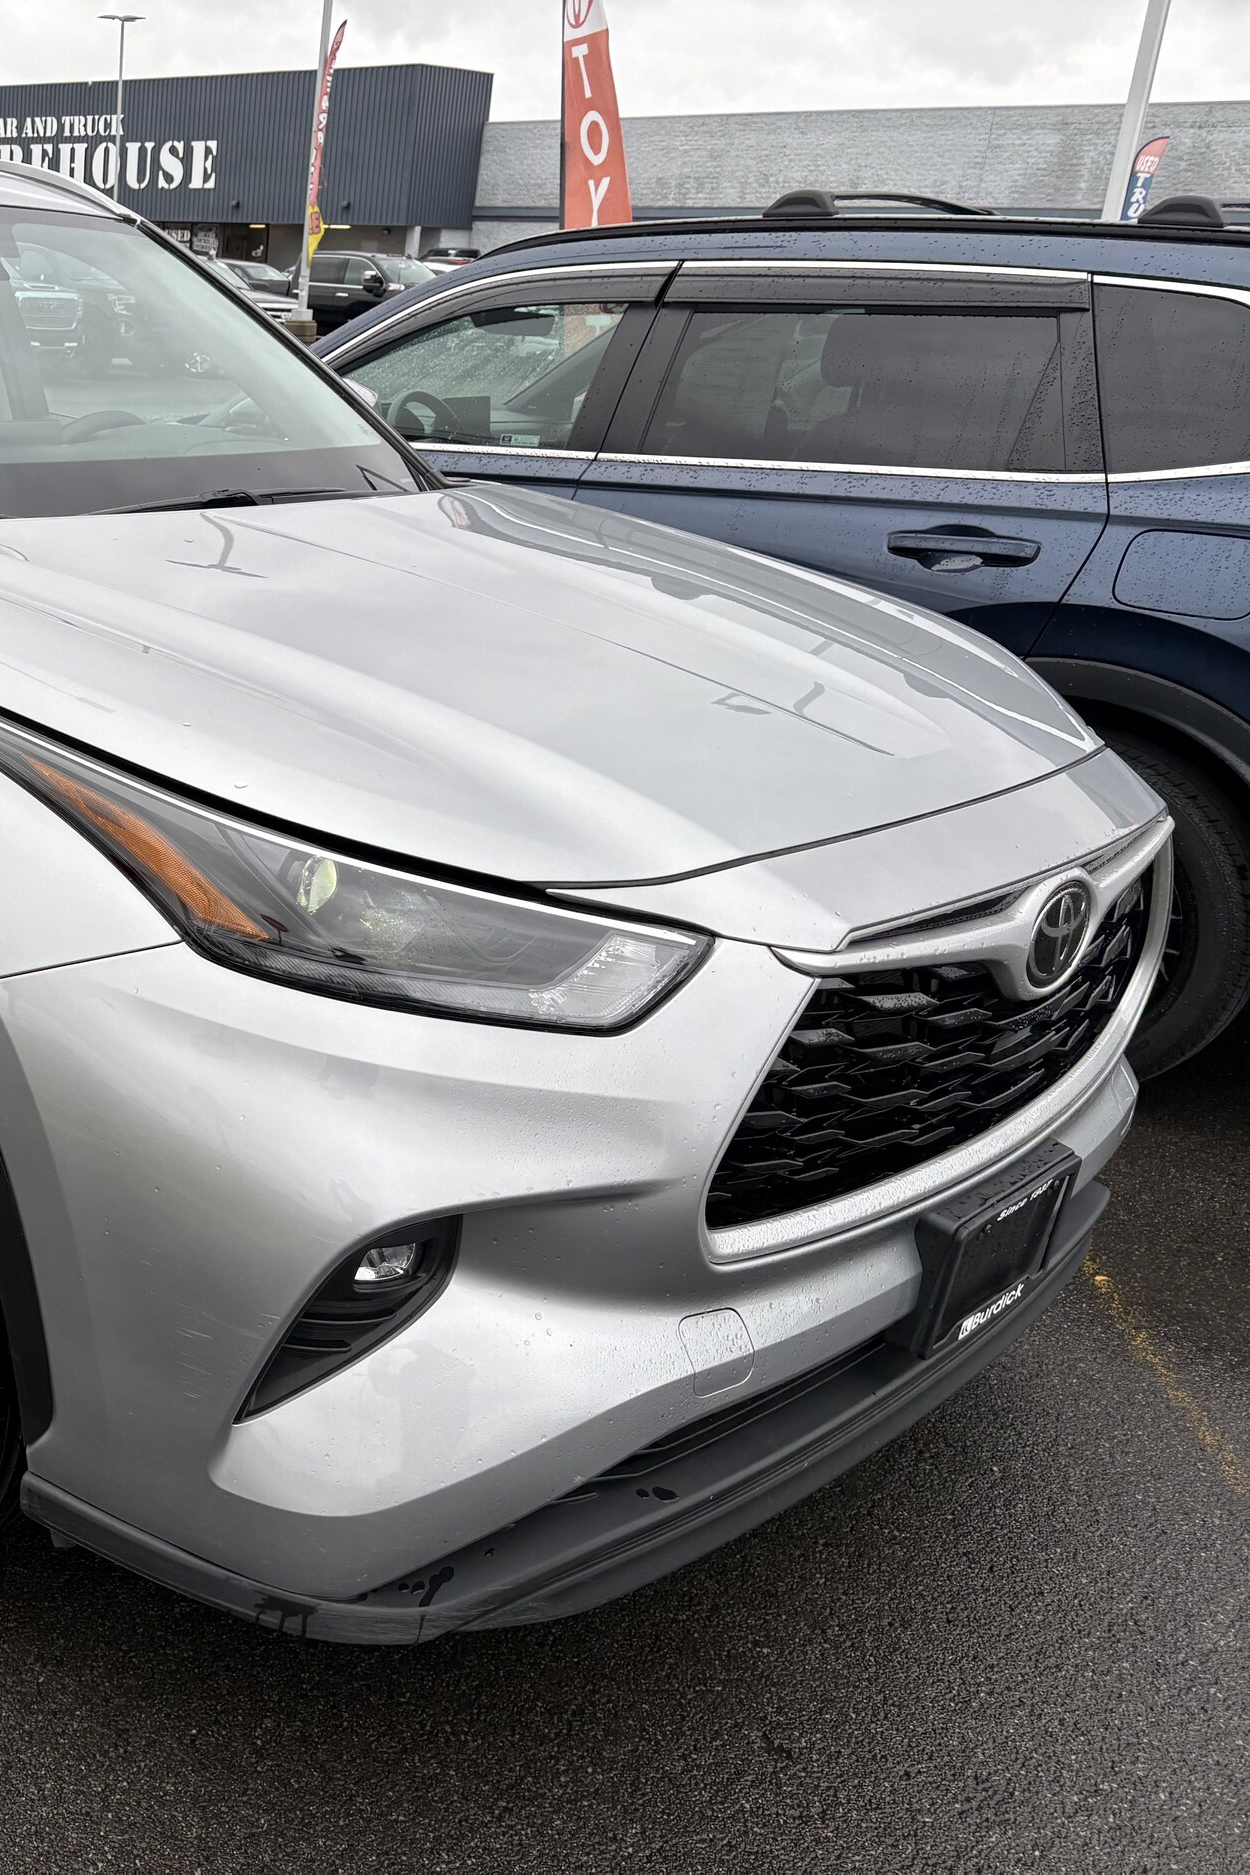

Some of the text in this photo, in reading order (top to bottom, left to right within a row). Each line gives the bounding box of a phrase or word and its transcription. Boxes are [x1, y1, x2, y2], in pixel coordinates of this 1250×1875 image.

[21, 116, 58, 138] AND
[61, 114, 125, 137] TRUCK
[571, 43, 611, 227] TOY
[1135, 155, 1160, 172] USED
[1124, 173, 1152, 222] TRU
[997, 1197, 1028, 1222] Since
[969, 1283, 1025, 1330] Burdick
